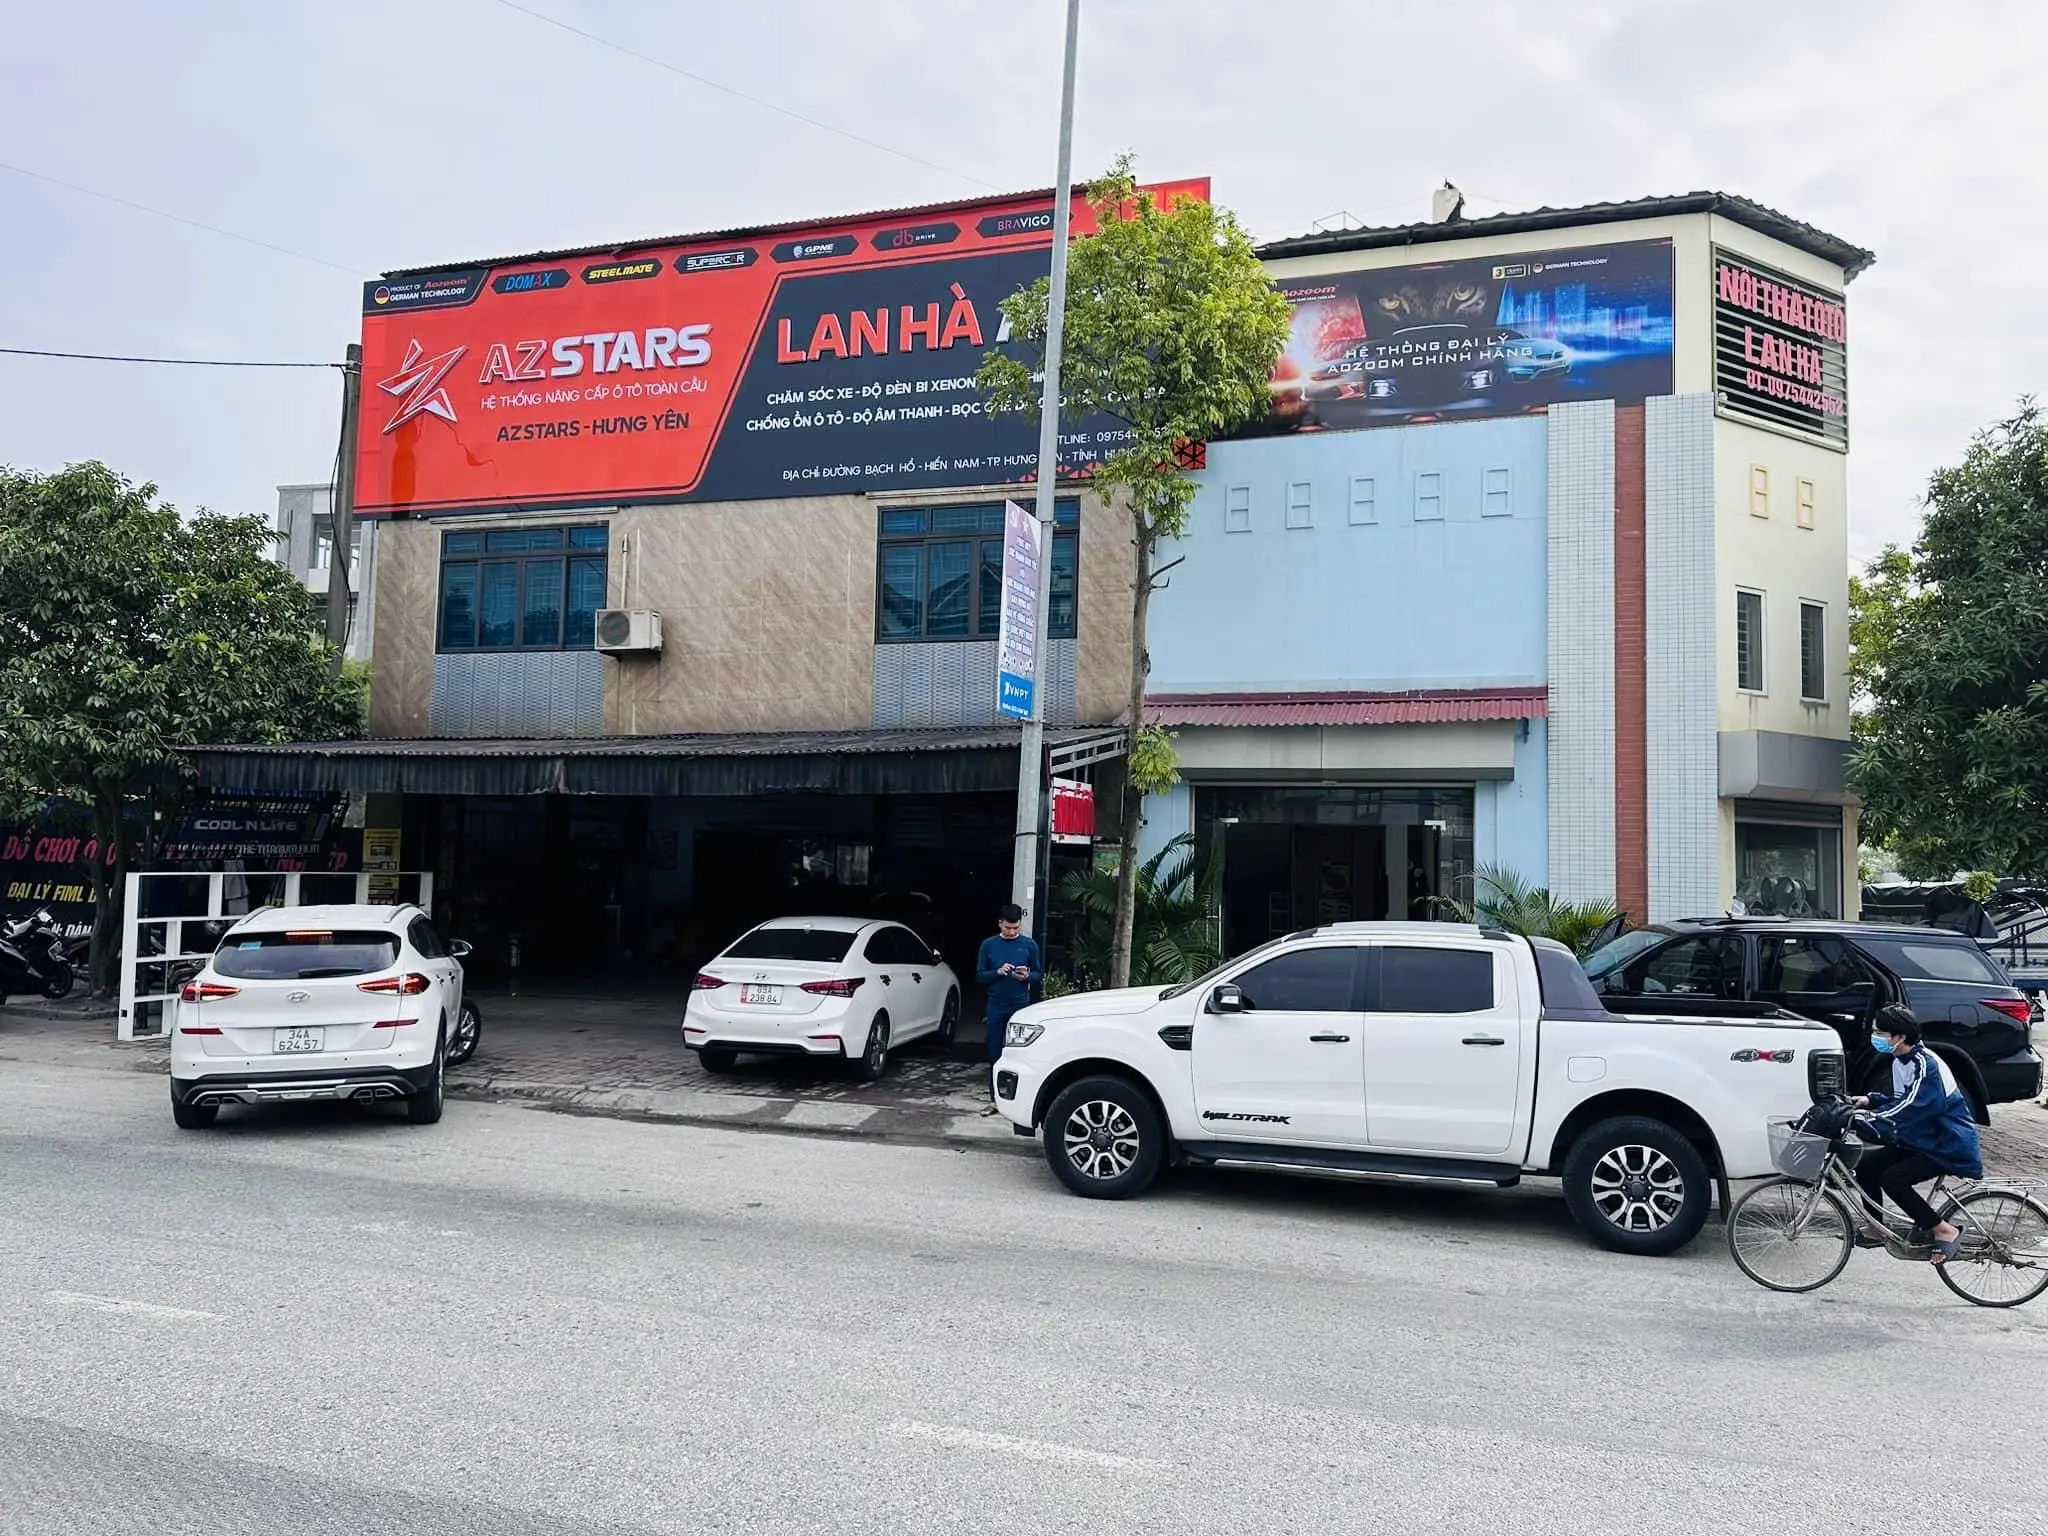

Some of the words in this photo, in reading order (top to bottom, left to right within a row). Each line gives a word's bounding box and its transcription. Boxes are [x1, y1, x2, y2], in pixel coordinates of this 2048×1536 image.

[998, 215, 1050, 231] BRAVIGO
[915, 233, 936, 243] DRIVE
[804, 243, 834, 253] GPNE
[687, 254, 744, 269] SUPERCAR
[588, 264, 653, 279] STEELMATE
[505, 272, 553, 291] DOMAX
[390, 293, 419, 302] GERMAN
[421, 287, 466, 299] TECHNOLOGY
[777, 308, 889, 365] LAN
[899, 282, 983, 353] HÀ
[1448, 337, 1478, 352] ĐẠI
[1486, 333, 1509, 345] LÝ
[1744, 325, 1793, 377] LAN
[1327, 358, 1404, 374] AOZOOM
[1412, 352, 1472, 367] CHÍNH
[481, 394, 496, 410] HỆ
[499, 389, 541, 408] THỐNG
[545, 388, 580, 405] NÂNG
[584, 384, 609, 401] CẤP
[613, 383, 622, 399] Ô
[625, 382, 642, 398] TÔ
[644, 379, 677, 396] TOÀN
[766, 390, 804, 405] CHĂM
[808, 386, 834, 402] SÓC
[836, 388, 853, 400] XE
[862, 382, 882, 399] ĐỘ
[885, 379, 912, 396] ĐÈN
[915, 381, 928, 393] BI
[931, 377, 976, 392] XENON
[592, 413, 648, 435] HƯNG
[652, 408, 689, 430] YÊN
[746, 413, 791, 431] CHỐNG
[814, 412, 825, 426] Ô
[826, 410, 844, 425] TÔ
[853, 408, 873, 425] ĐỘ
[874, 407, 896, 422] ÂM
[898, 405, 943, 420] THANH
[952, 402, 981, 418] BỌC
[783, 469, 799, 481] ĐỊA
[822, 464, 861, 477] ĐƯỜNG
[864, 463, 894, 476] BẠCH
[954, 458, 979, 470] NAM
[1004, 454, 1038, 466] HƯNG
[1009, 685, 1029, 701] VNPT
[34, 836, 80, 864] CHƠI
[7, 882, 32, 902] ĐẠI
[34, 880, 52, 901] LÝ
[288, 1029, 310, 1040] 34A
[278, 1039, 318, 1051] 624.57
[1202, 1110, 1292, 1125] WILDTRAK
